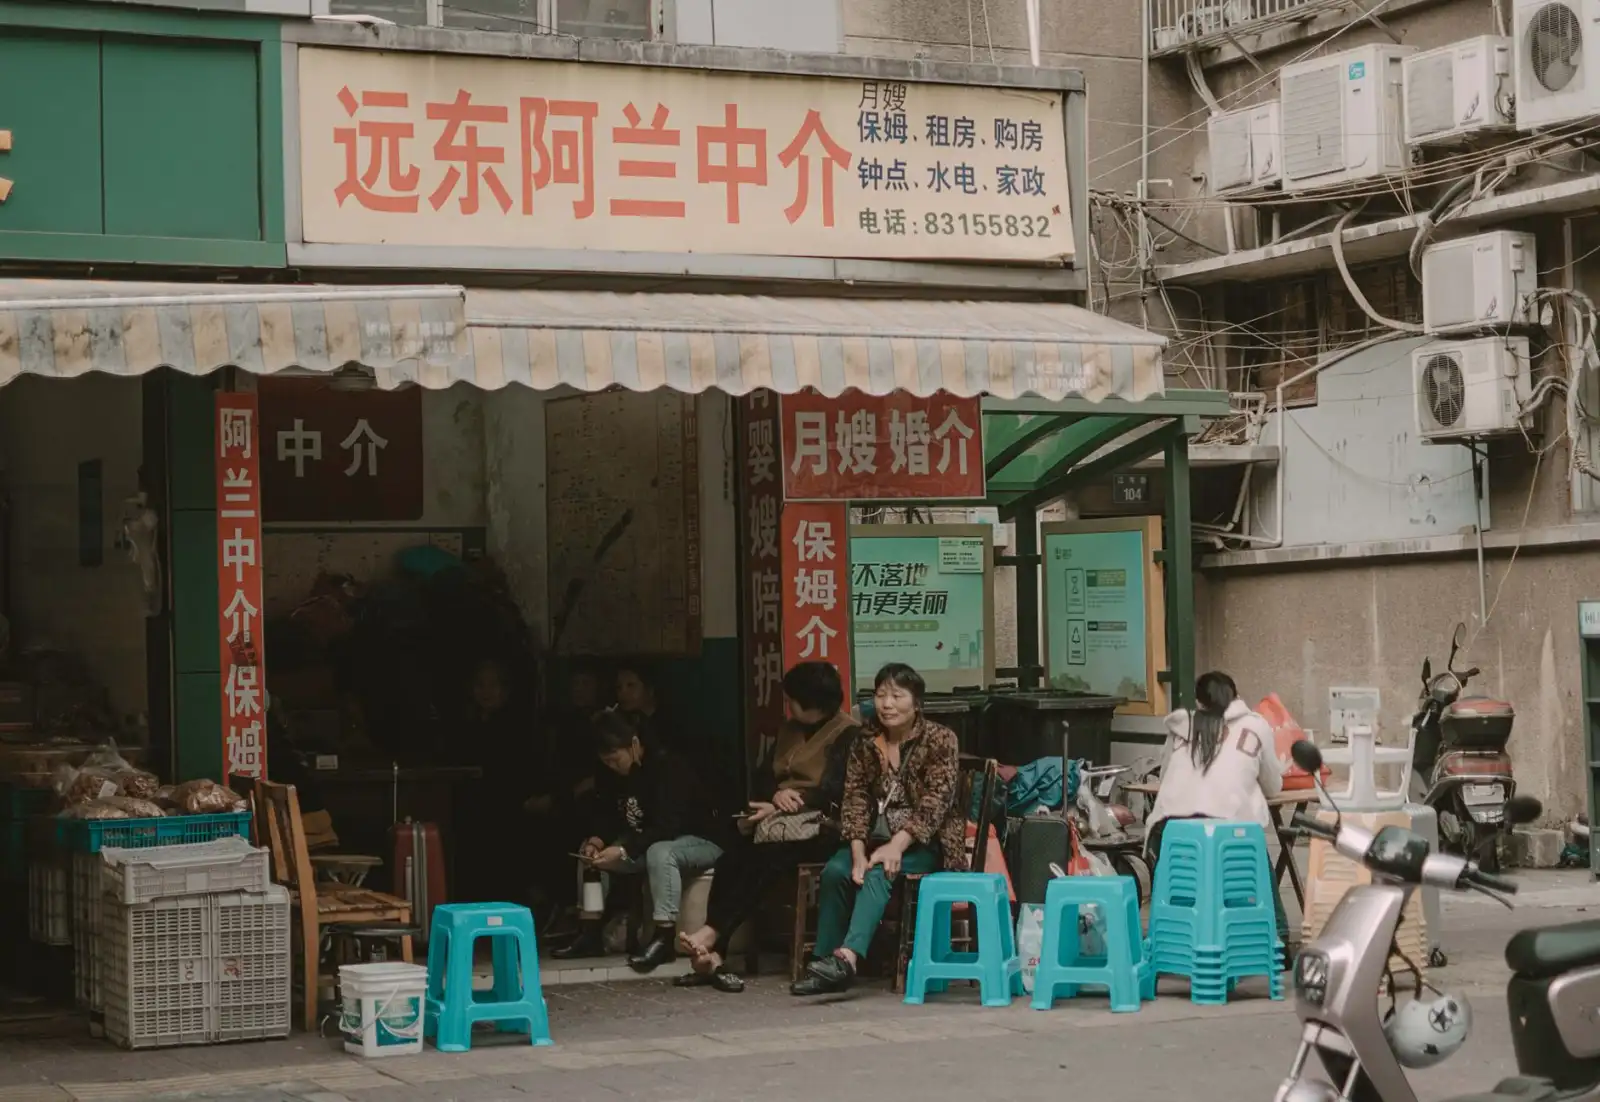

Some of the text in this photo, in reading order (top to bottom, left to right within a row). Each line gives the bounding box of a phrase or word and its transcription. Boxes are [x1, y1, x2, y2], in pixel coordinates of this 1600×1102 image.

[859, 82, 907, 112] 月嫂
[333, 85, 852, 227] 远东阿兰中介
[857, 110, 1043, 151] 保姆、租房、购房
[857, 157, 1047, 196] 钟点、水电、家政
[277, 419, 388, 477] 中介
[791, 408, 974, 476] 月嫂婚介
[220, 408, 262, 778] 阿兰中介保姆
[792, 519, 838, 674] 保姆介
[852, 563, 930, 588] 不落地
